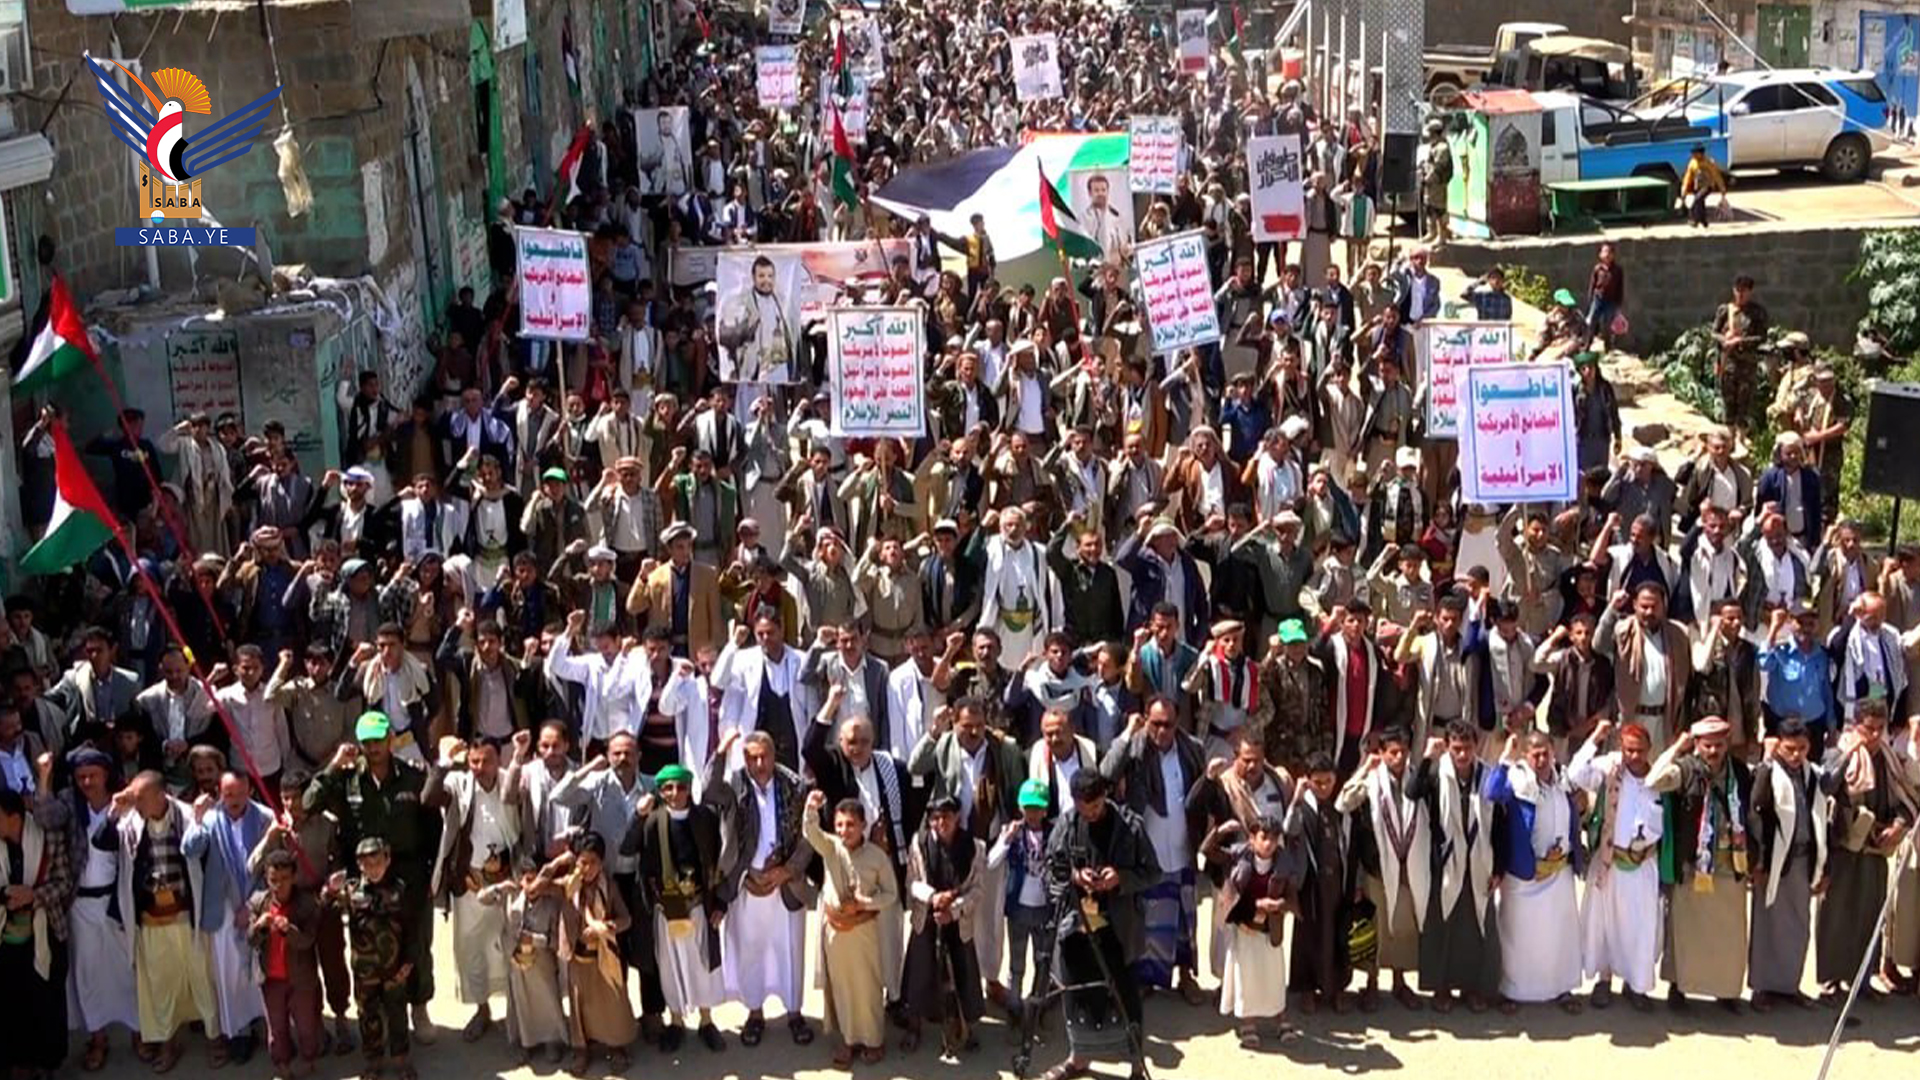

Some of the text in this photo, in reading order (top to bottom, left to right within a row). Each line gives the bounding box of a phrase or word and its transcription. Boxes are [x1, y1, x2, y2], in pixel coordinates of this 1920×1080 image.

[522, 238, 583, 260] قاطعوا
[1179, 241, 1202, 260] الله
[885, 317, 914, 336] الله
[1479, 328, 1507, 345] الله
[882, 342, 914, 359] الموت
[882, 363, 915, 380] الموت
[1474, 375, 1559, 405] قاطعوا
[883, 401, 917, 425] النصر
[1476, 408, 1560, 435] البضائع الأمريكية
[1515, 439, 1521, 457] و
[1480, 462, 1563, 488] الإسرائيلية
